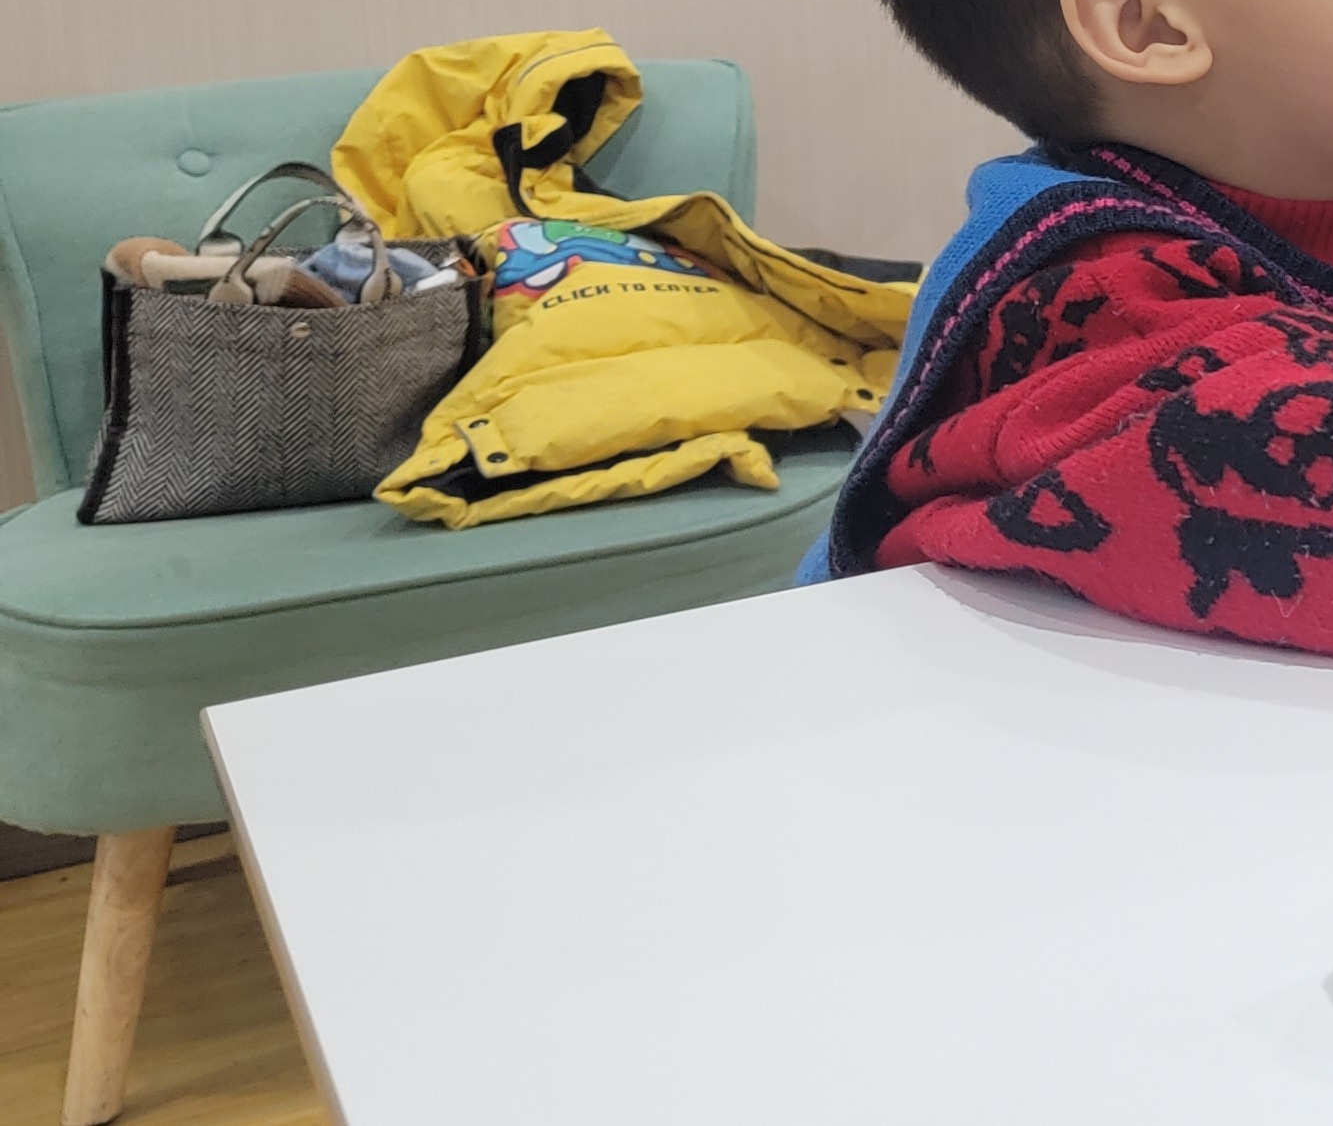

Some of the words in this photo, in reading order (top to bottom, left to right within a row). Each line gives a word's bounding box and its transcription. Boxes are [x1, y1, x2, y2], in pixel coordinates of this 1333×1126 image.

[542, 284, 611, 310] CLICK
[617, 282, 648, 293] TO
[653, 282, 720, 294] ENTER
